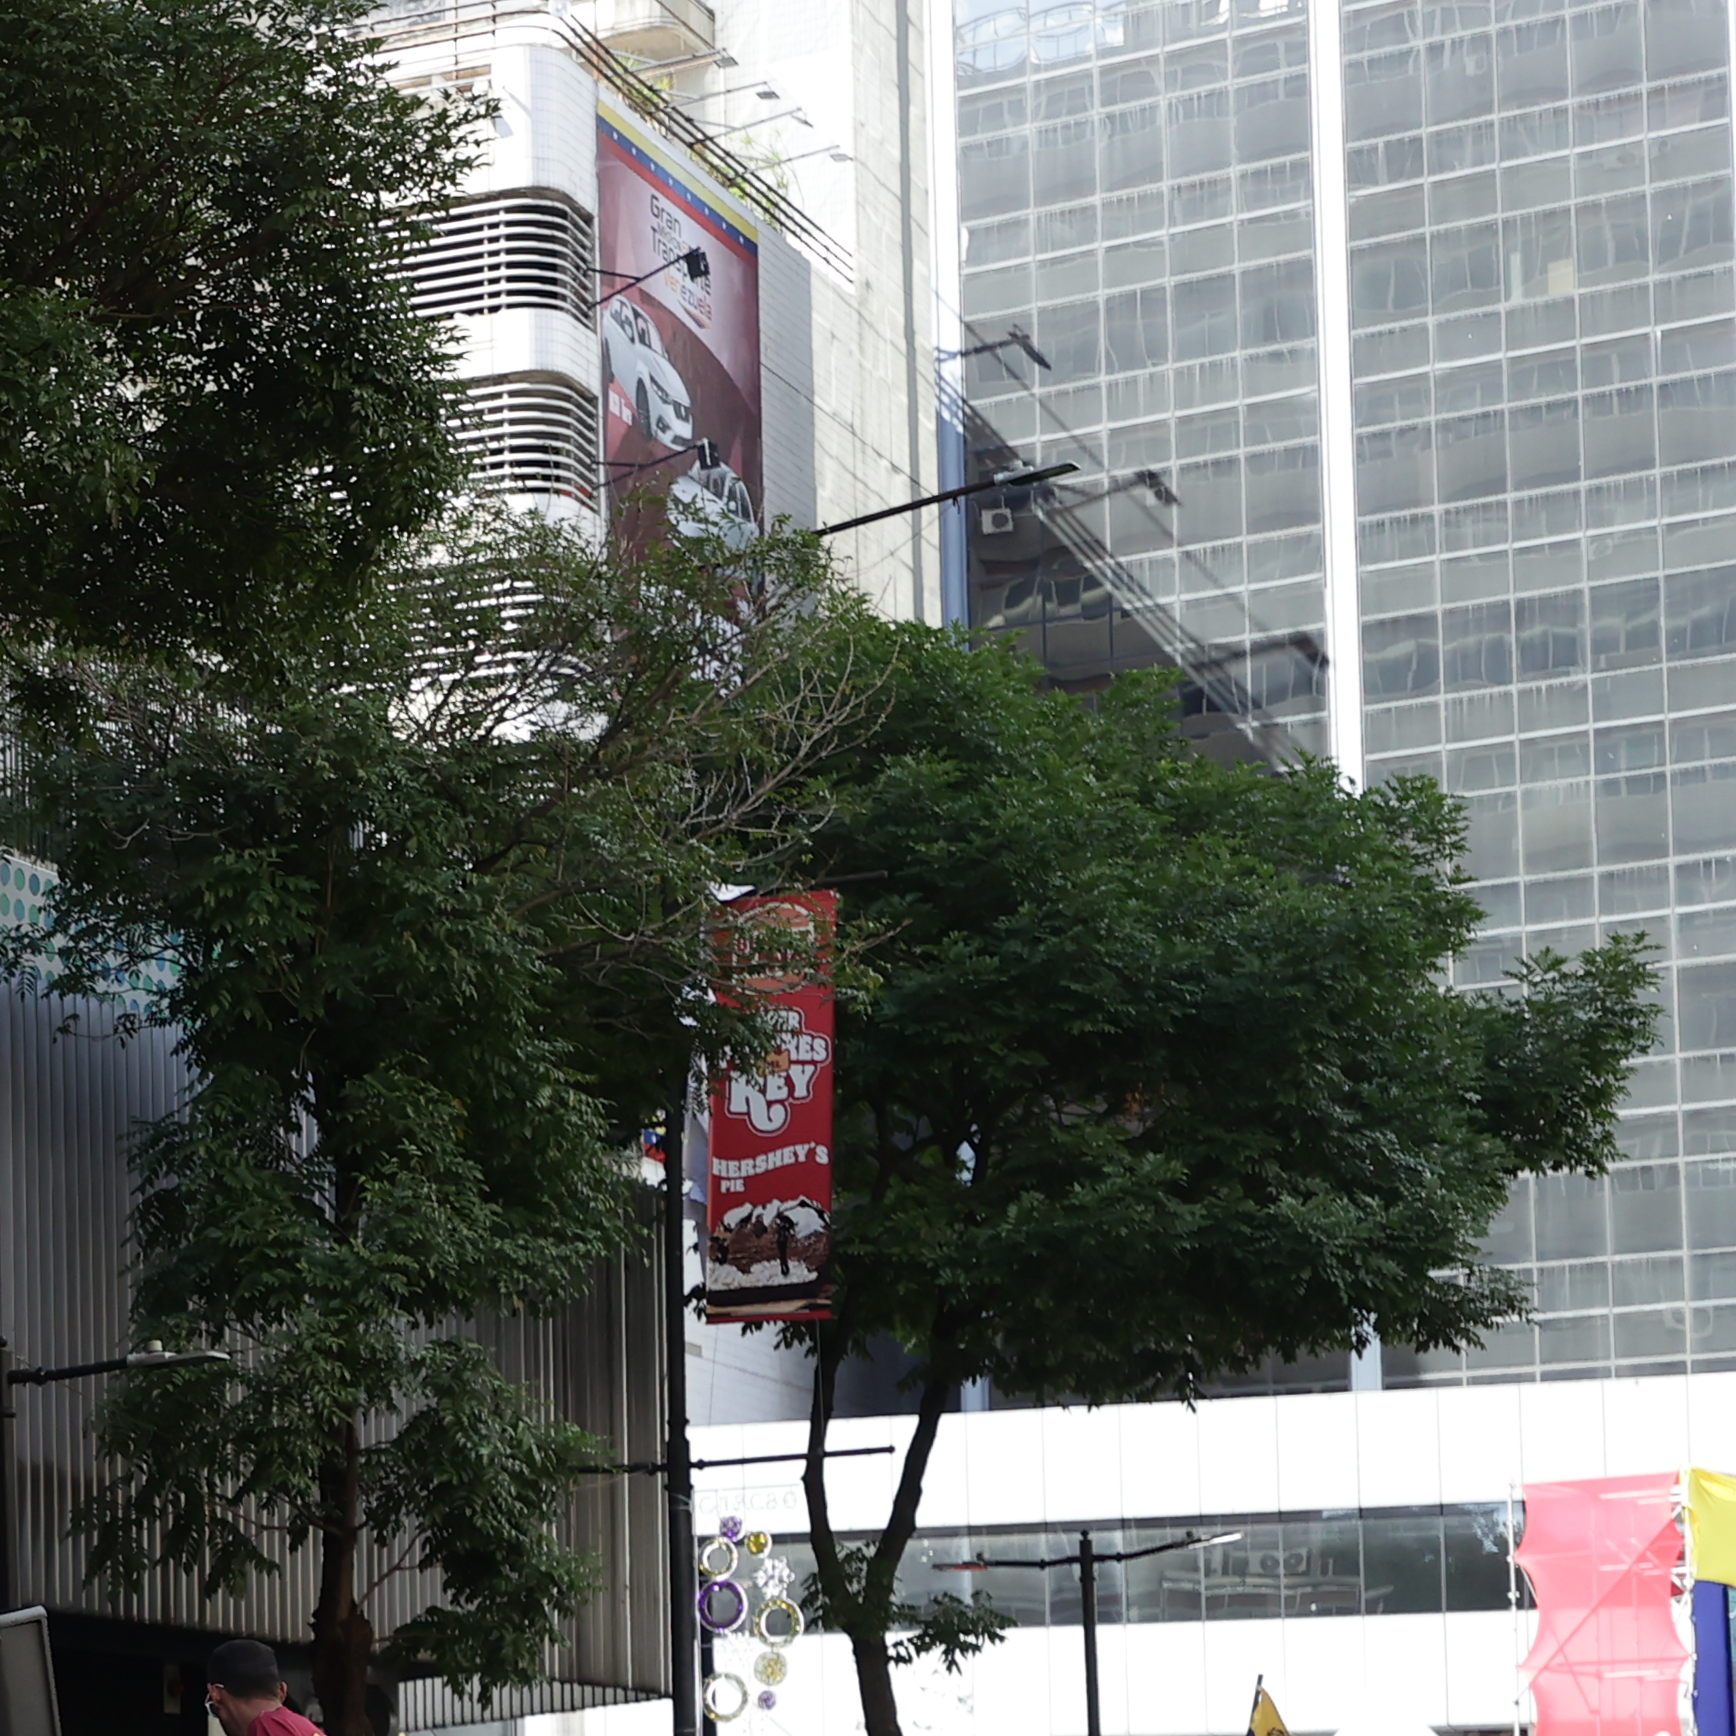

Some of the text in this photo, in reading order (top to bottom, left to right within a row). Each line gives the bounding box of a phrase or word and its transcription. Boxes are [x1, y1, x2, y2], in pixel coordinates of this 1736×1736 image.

[650, 193, 682, 239] Gran
[712, 1141, 829, 1178] HERSHEY'S
[720, 1179, 745, 1193] PIE
